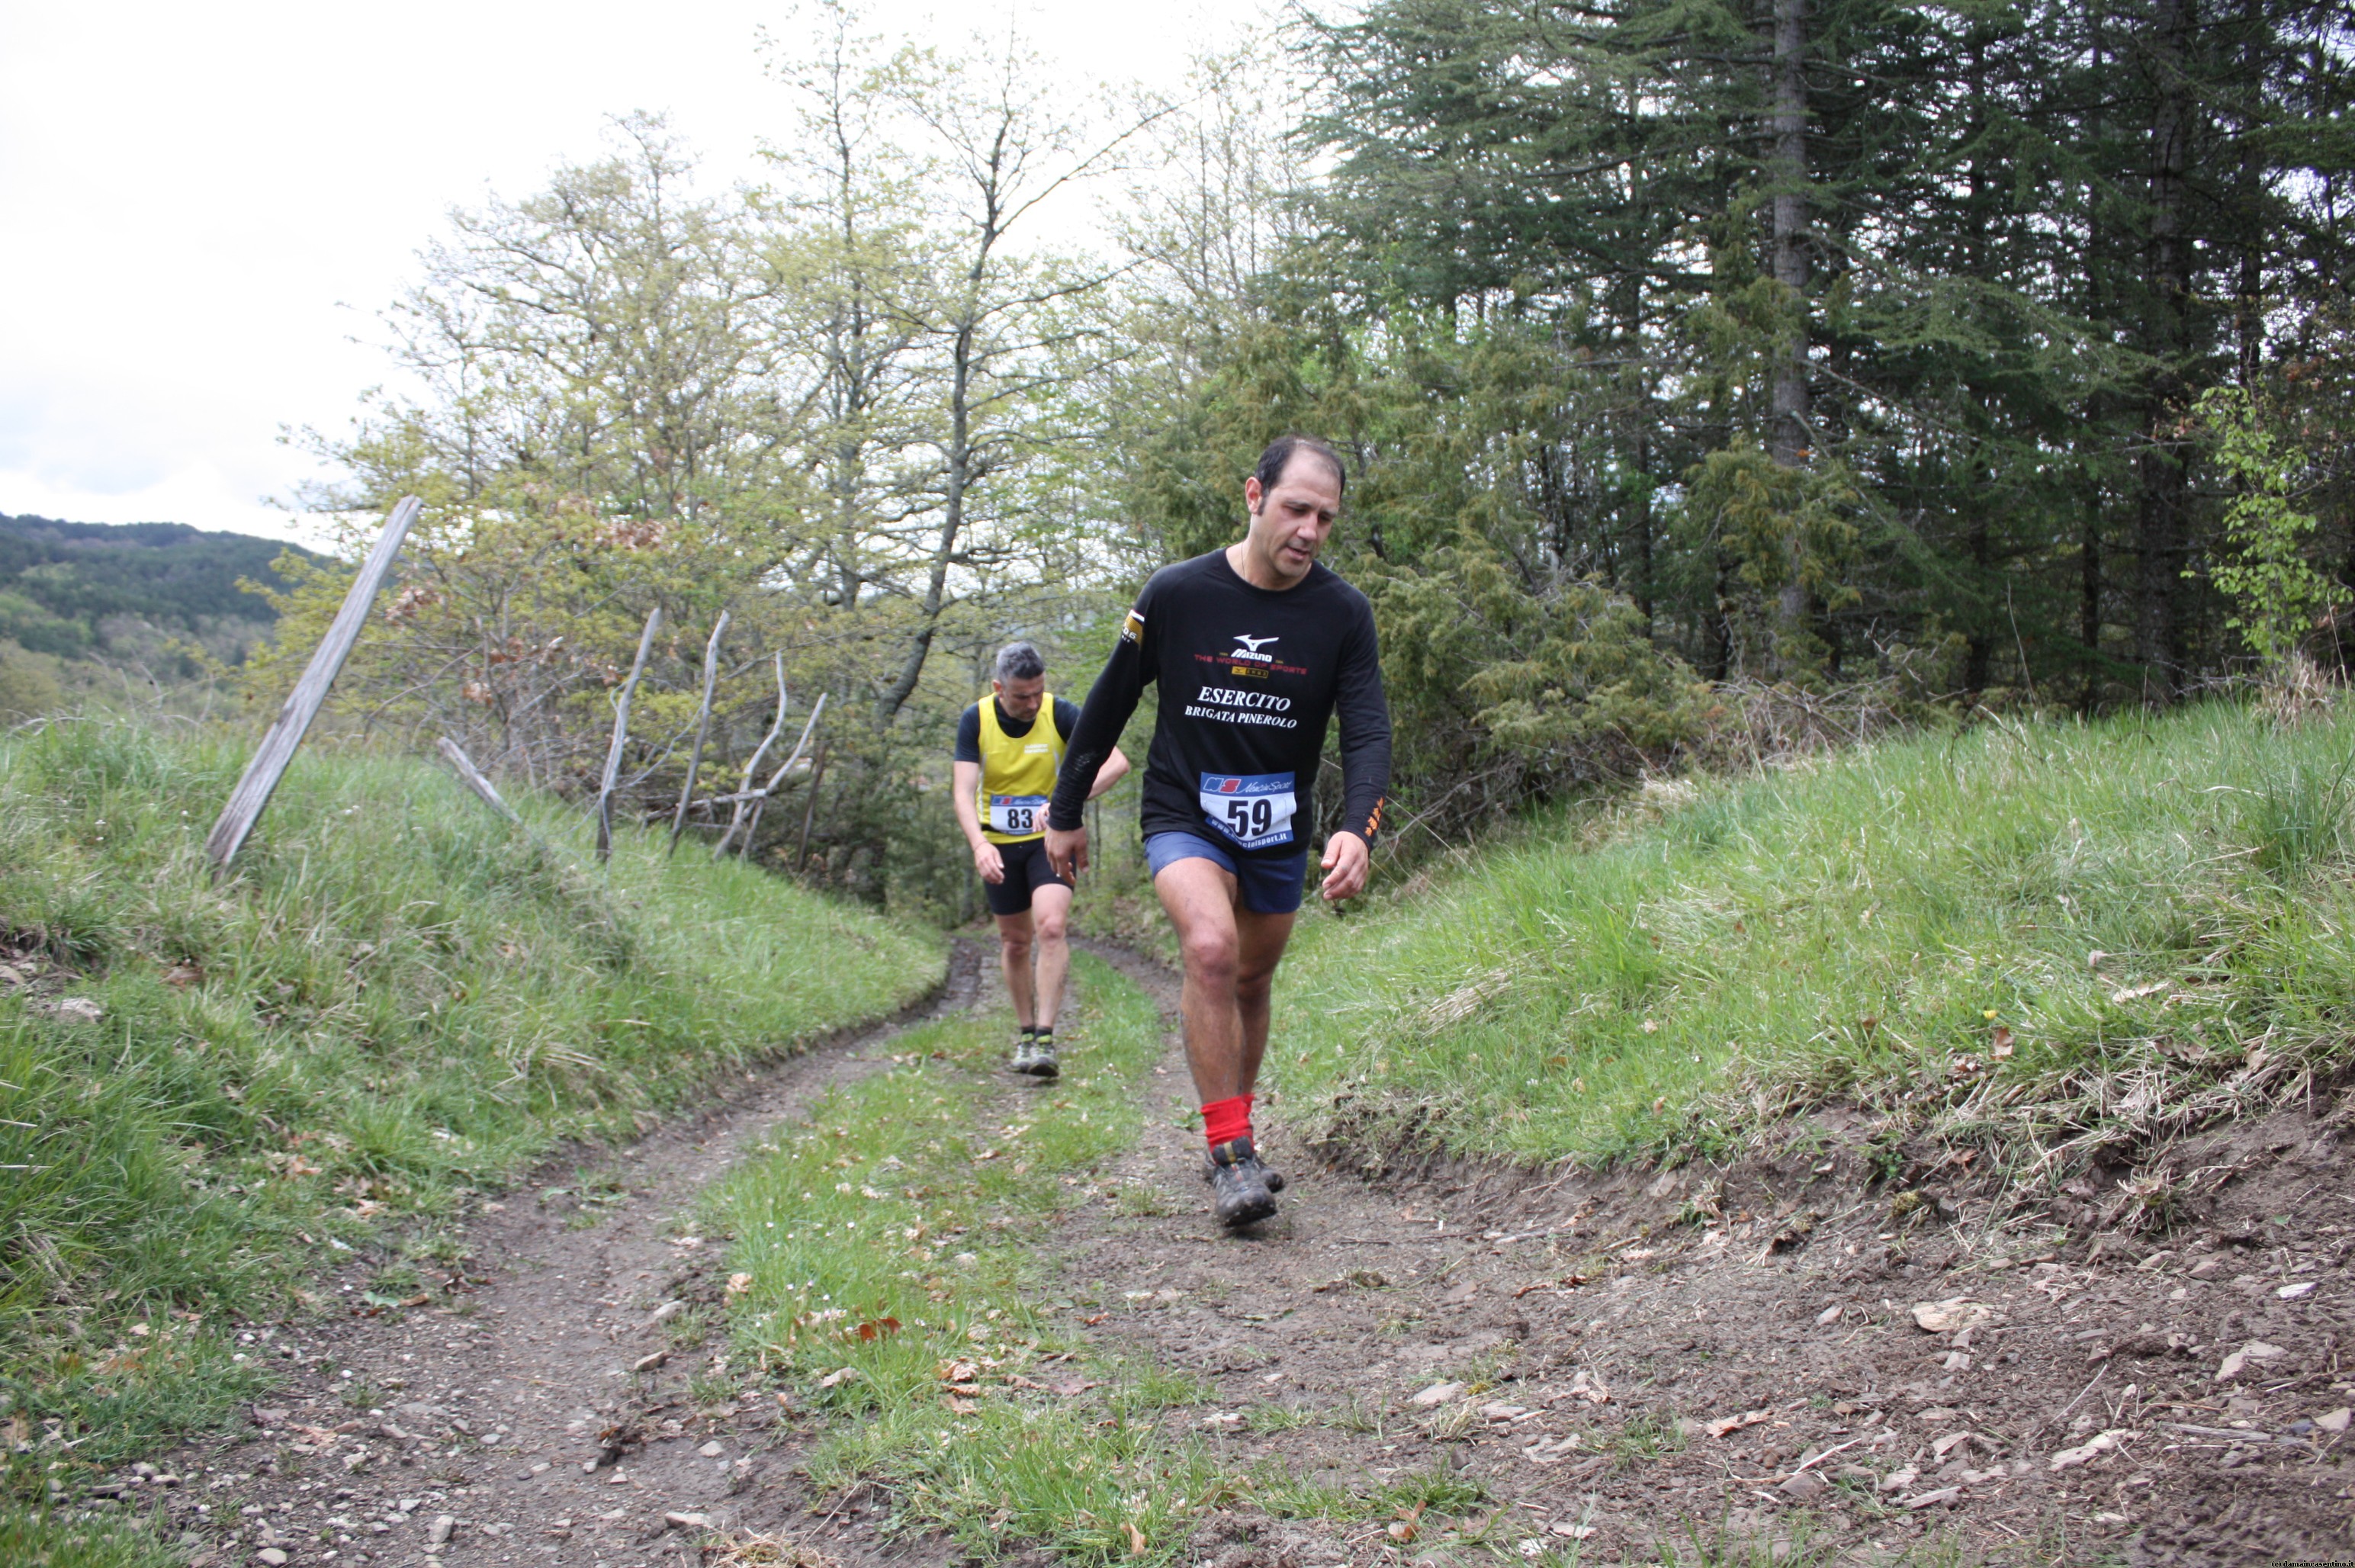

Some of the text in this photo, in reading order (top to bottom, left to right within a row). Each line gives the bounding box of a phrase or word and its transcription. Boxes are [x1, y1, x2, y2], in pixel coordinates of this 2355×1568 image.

[1194, 654, 1213, 663] THE
[1216, 657, 1251, 667] WORLD
[1270, 664, 1308, 675] SPORTS
[1197, 686, 1291, 712] ESERCITO
[1184, 705, 1297, 729] BRIGATA PINEROLO
[1007, 808, 1033, 829] 83
[1226, 798, 1272, 837] 59
